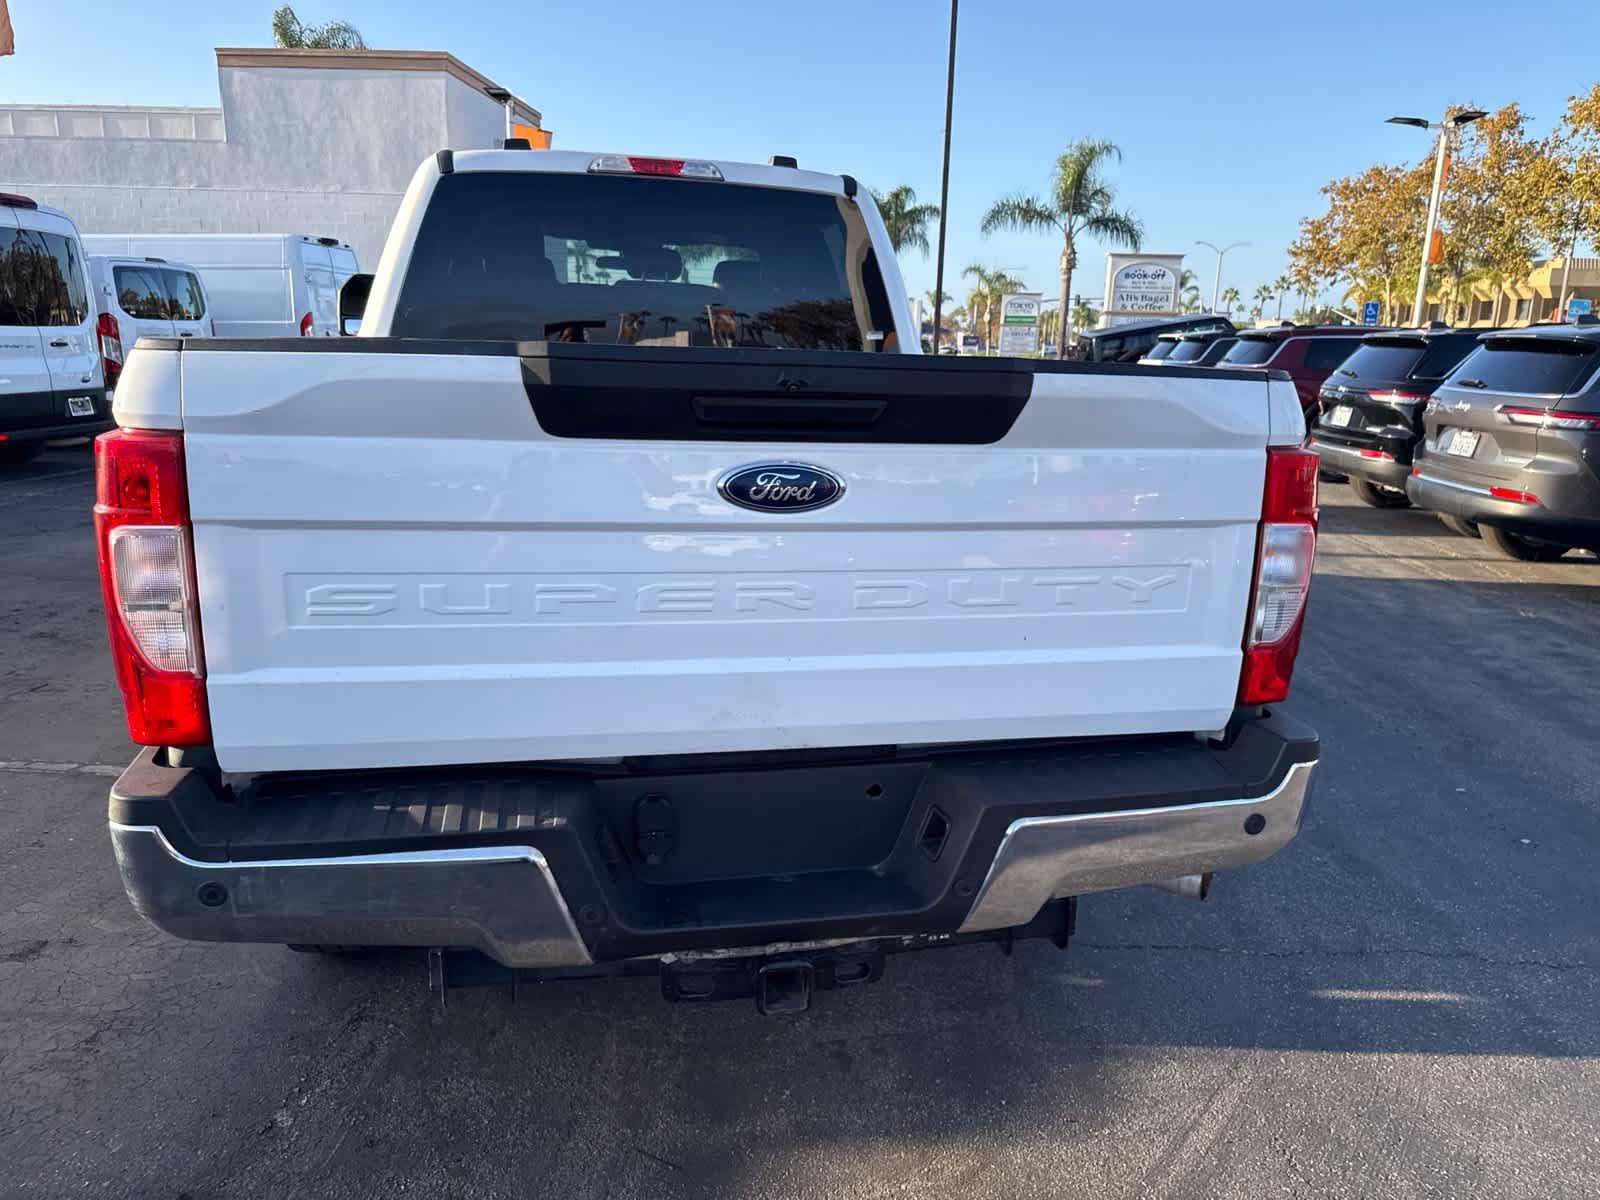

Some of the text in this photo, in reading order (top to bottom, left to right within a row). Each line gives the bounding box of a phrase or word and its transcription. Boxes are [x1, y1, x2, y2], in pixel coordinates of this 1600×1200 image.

[1141, 294, 1169, 304] Bagel
[749, 472, 817, 501] Ford
[306, 574, 1177, 617] SUPER DUTY
